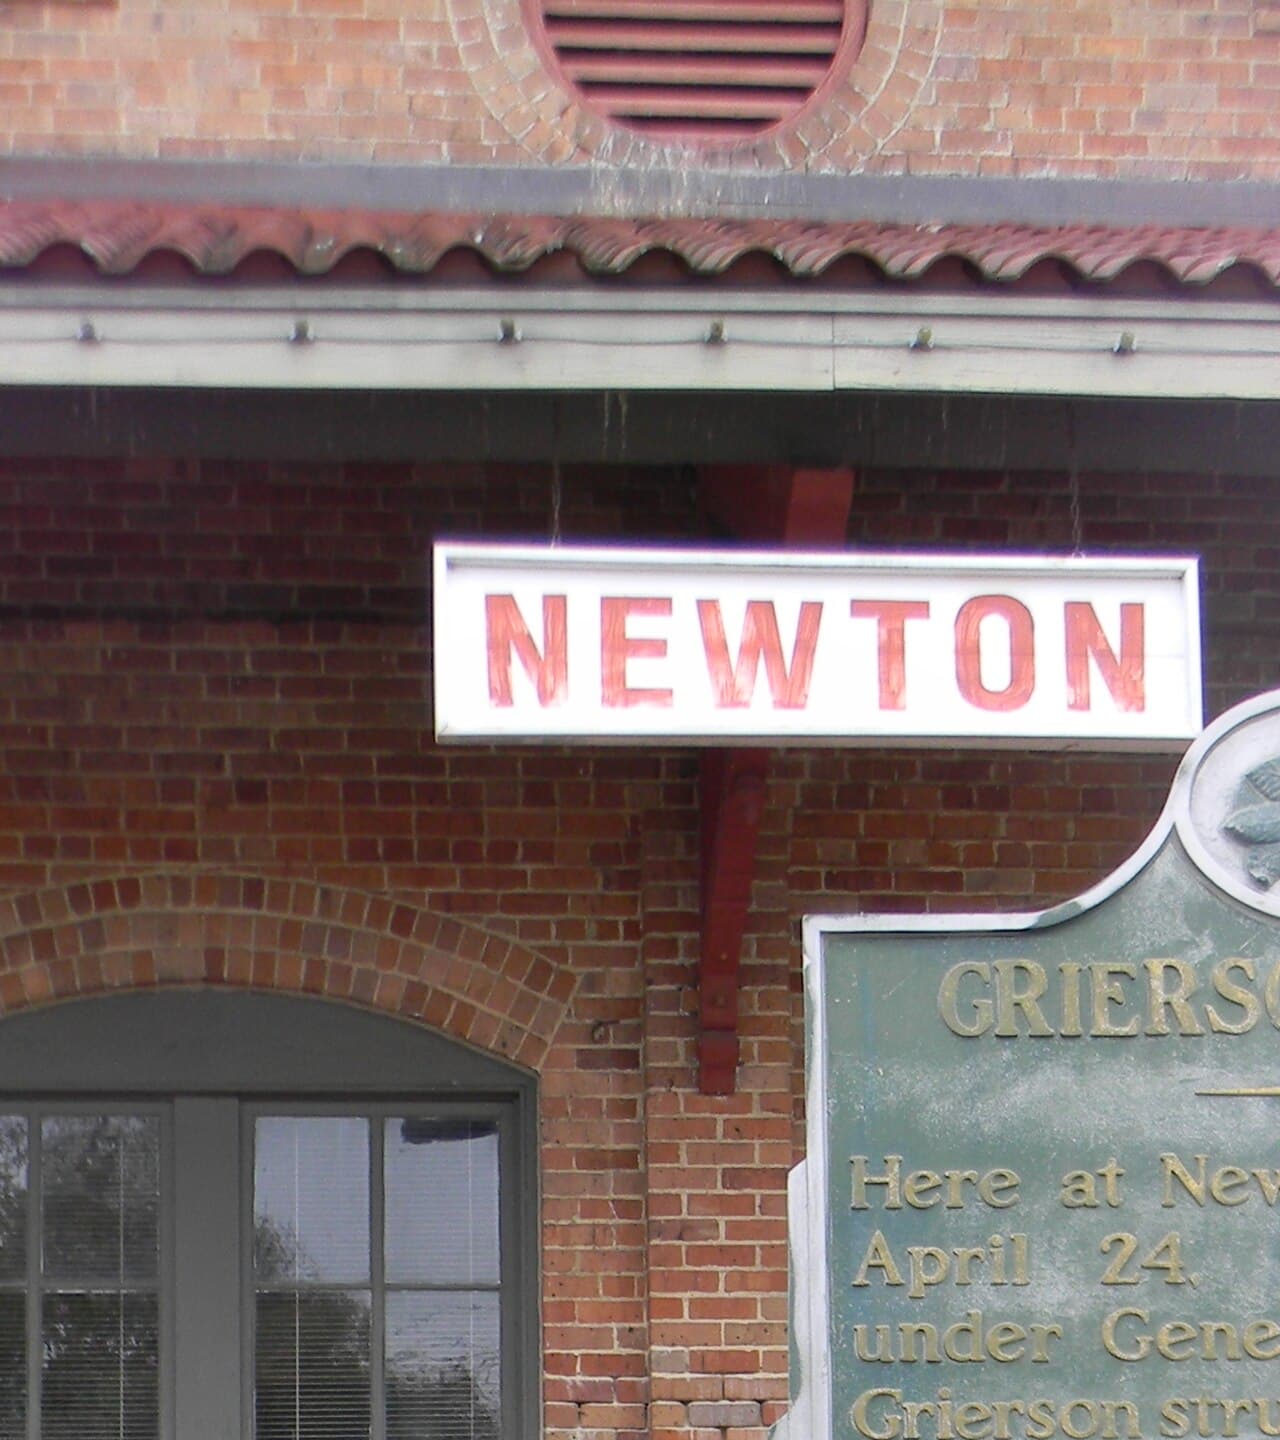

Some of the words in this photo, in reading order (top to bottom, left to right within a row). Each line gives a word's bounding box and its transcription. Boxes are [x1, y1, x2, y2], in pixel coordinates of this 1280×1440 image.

[483, 593, 1147, 713] NEWTON
[849, 1154, 1021, 1210] Here
[1061, 1157, 1126, 1209] at
[851, 1229, 1032, 1299] April
[853, 1307, 1064, 1364] under
